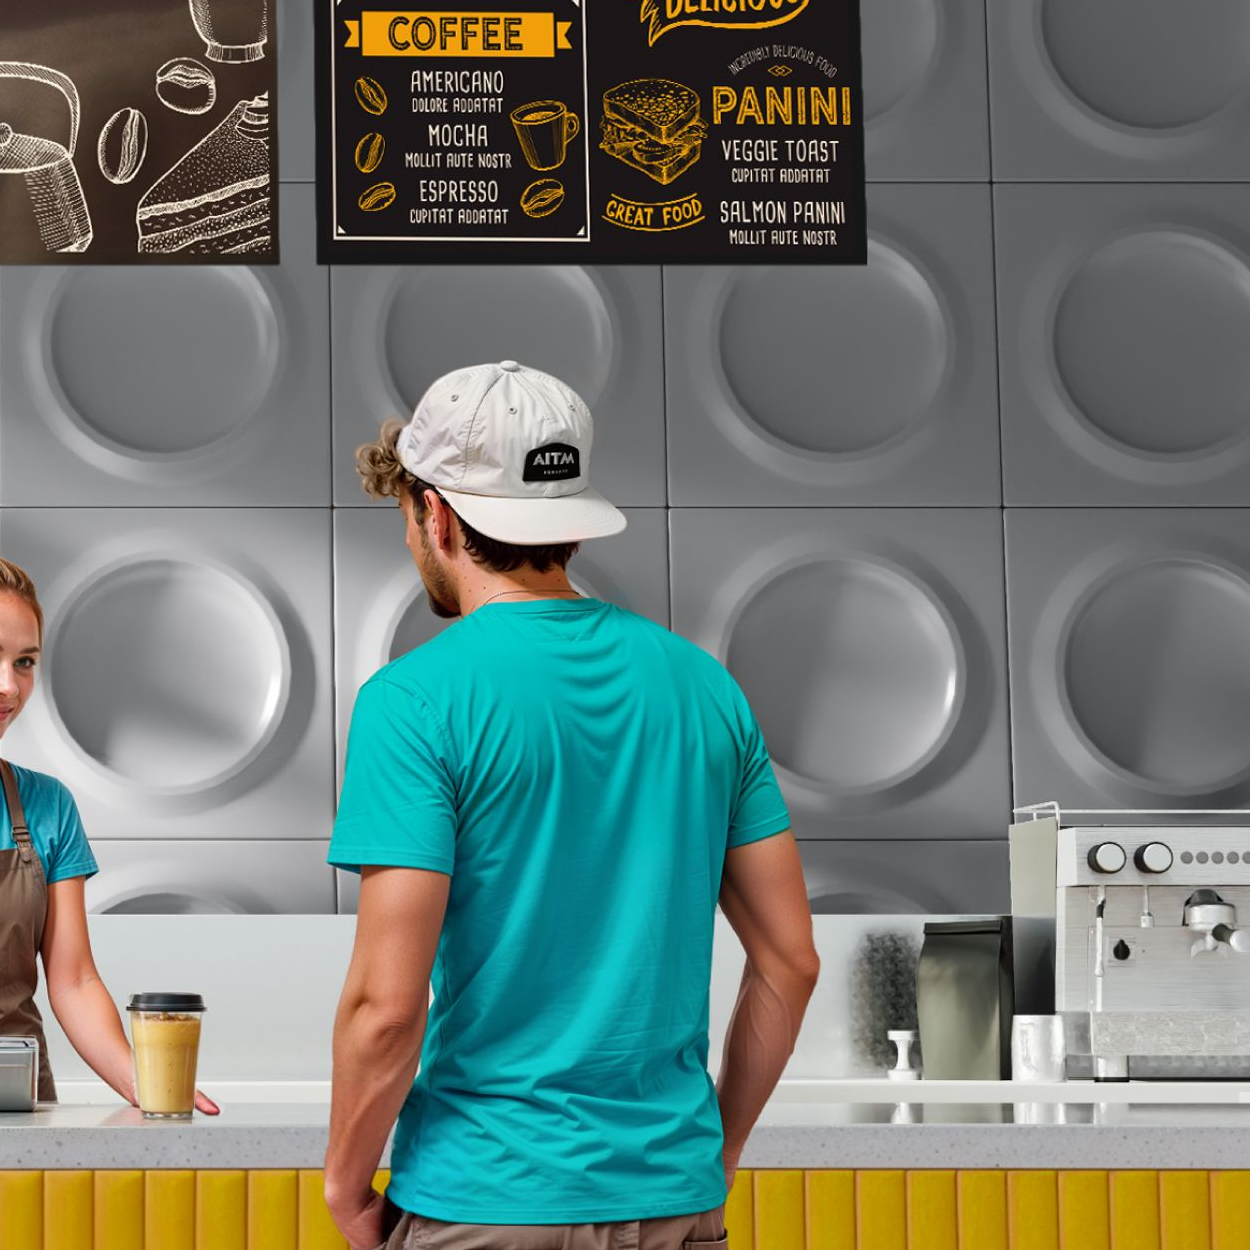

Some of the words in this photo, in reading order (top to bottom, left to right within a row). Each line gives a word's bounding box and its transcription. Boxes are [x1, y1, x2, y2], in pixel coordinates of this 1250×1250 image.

[388, 16, 524, 51] COFFEE
[772, 44, 815, 65] DELICIOUS
[814, 55, 838, 78] FOOD
[411, 70, 504, 93] AMERICANO
[412, 98, 448, 112] DOLORE
[453, 97, 503, 112] ADDATAT
[712, 86, 851, 125] PANINI
[428, 124, 488, 146] MOCHA
[405, 153, 442, 168] MOLLIT
[446, 153, 473, 168] AUTE
[478, 153, 512, 168] NOSTR
[721, 140, 778, 162] VEGGIE
[785, 140, 839, 162] TOAST
[731, 168, 775, 183] CUPITAT
[780, 168, 831, 183] ADDATAT
[419, 180, 498, 202] ESPRESSO
[410, 209, 453, 224] CUPITAT
[458, 209, 509, 224] ADDATAT
[606, 200, 654, 225] GREAT
[662, 199, 702, 224] FOOD
[719, 200, 786, 223] SALMON
[793, 201, 846, 224] PANINI
[729, 229, 766, 245] MOLLIT
[771, 230, 798, 245] AUTE
[803, 230, 837, 246] NOSTR
[533, 452, 575, 466] AITM
